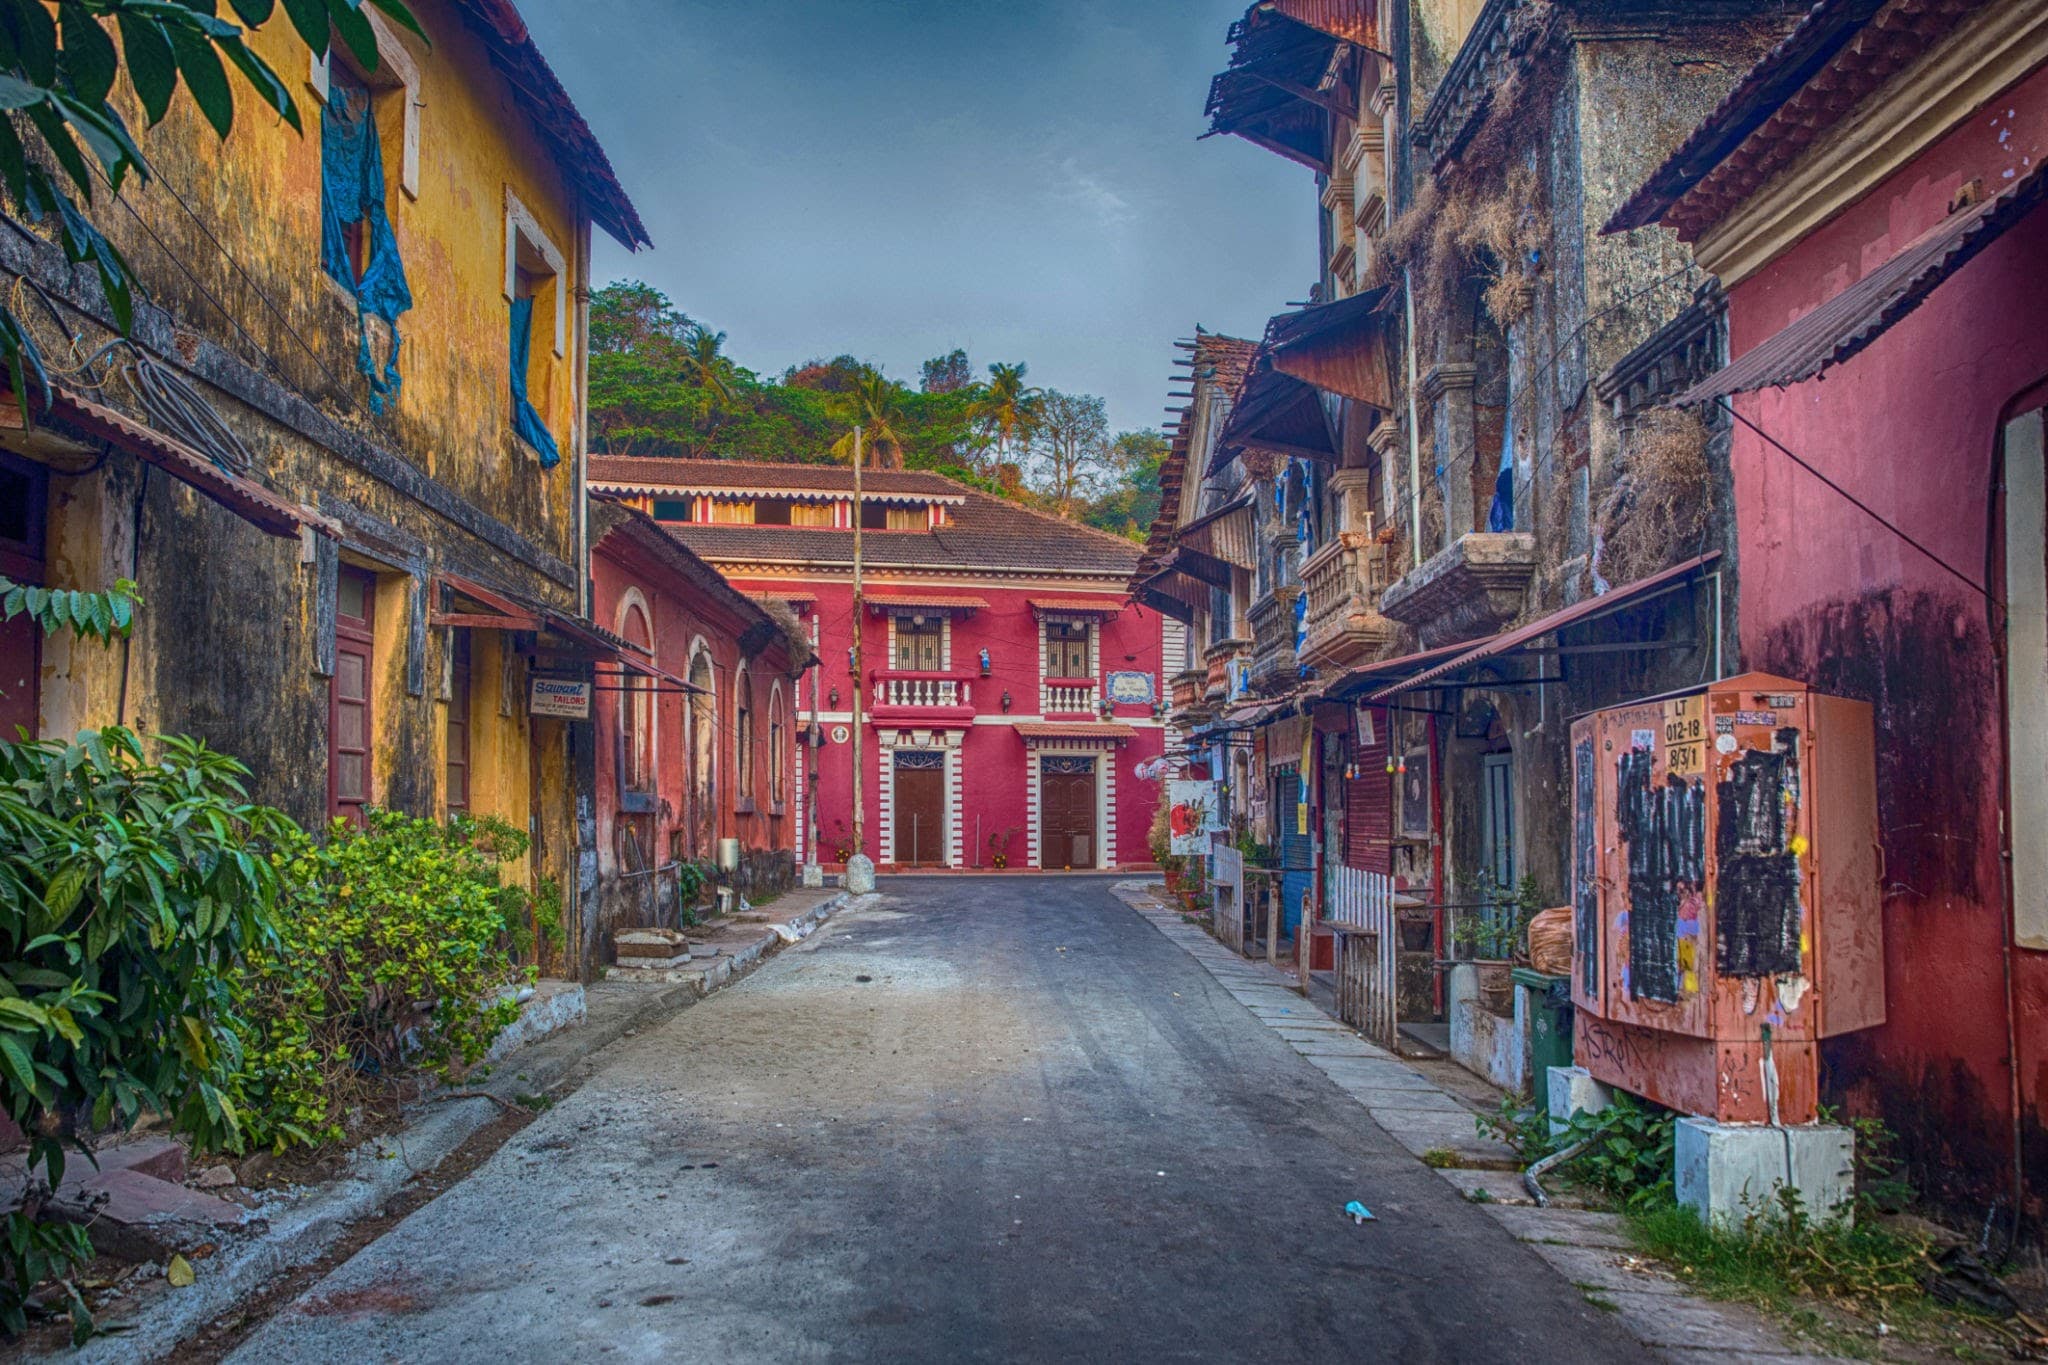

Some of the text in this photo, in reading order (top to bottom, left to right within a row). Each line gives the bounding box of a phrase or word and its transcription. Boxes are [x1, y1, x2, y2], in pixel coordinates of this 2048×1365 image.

[535, 682, 584, 695] Sawant
[553, 696, 586, 705] TAILORS
[1675, 699, 1688, 716] LT
[1666, 718, 1700, 741] 012-18
[1670, 746, 1697, 771] 8/3/1
